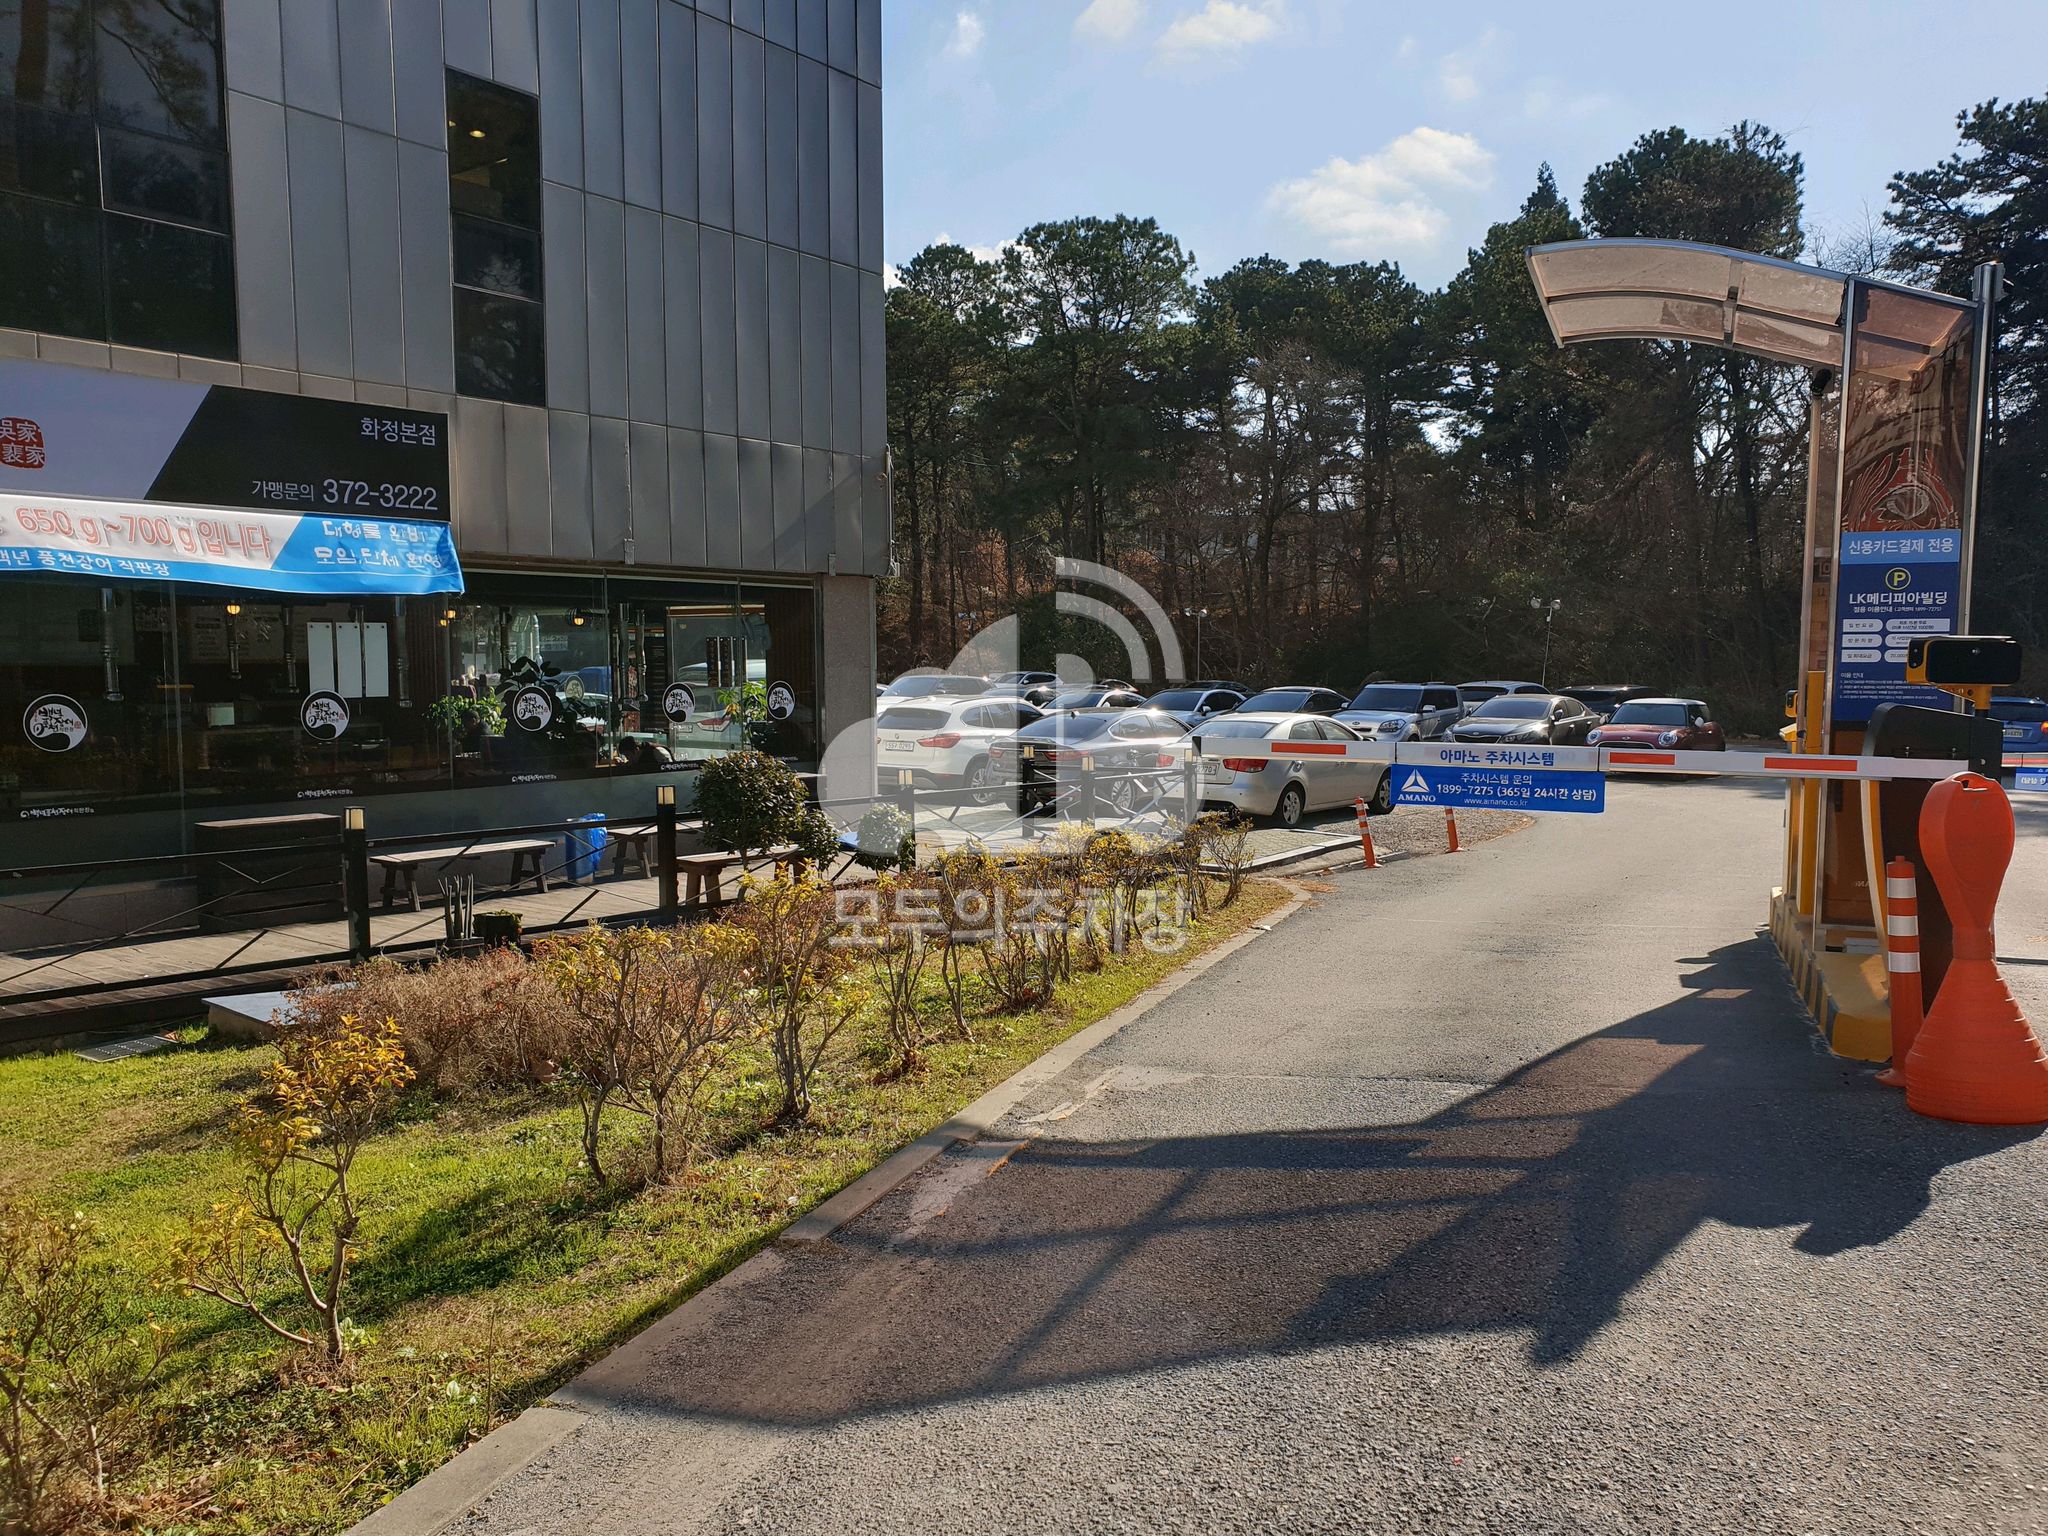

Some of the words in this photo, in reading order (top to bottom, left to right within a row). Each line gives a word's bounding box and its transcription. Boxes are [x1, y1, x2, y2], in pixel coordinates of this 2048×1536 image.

[360, 418, 437, 447] 화정본점
[251, 479, 314, 502] 가맹문의
[323, 478, 438, 511] 372-3222
[1848, 538, 1924, 555] 신용카드결제
[1928, 537, 1954, 554] 전용
[37, 550, 113, 573] 풍천장어
[118, 561, 170, 577] 직판장
[1892, 571, 1906, 587] P
[1849, 592, 1948, 605] LK메디피아빌딩
[1440, 750, 1480, 764] 아마노
[1485, 750, 1555, 766] 주차시스템
[1461, 773, 1509, 784] 주차시스템
[1513, 774, 1532, 785] 문의
[1398, 794, 1436, 803] AMANO
[1437, 784, 1494, 796] 1899-7275
[1497, 786, 1530, 799] (365일
[1534, 788, 1568, 799] 24시간
[1571, 788, 1597, 801] 상담)
[1464, 798, 1528, 807] www.amano.co.kr
